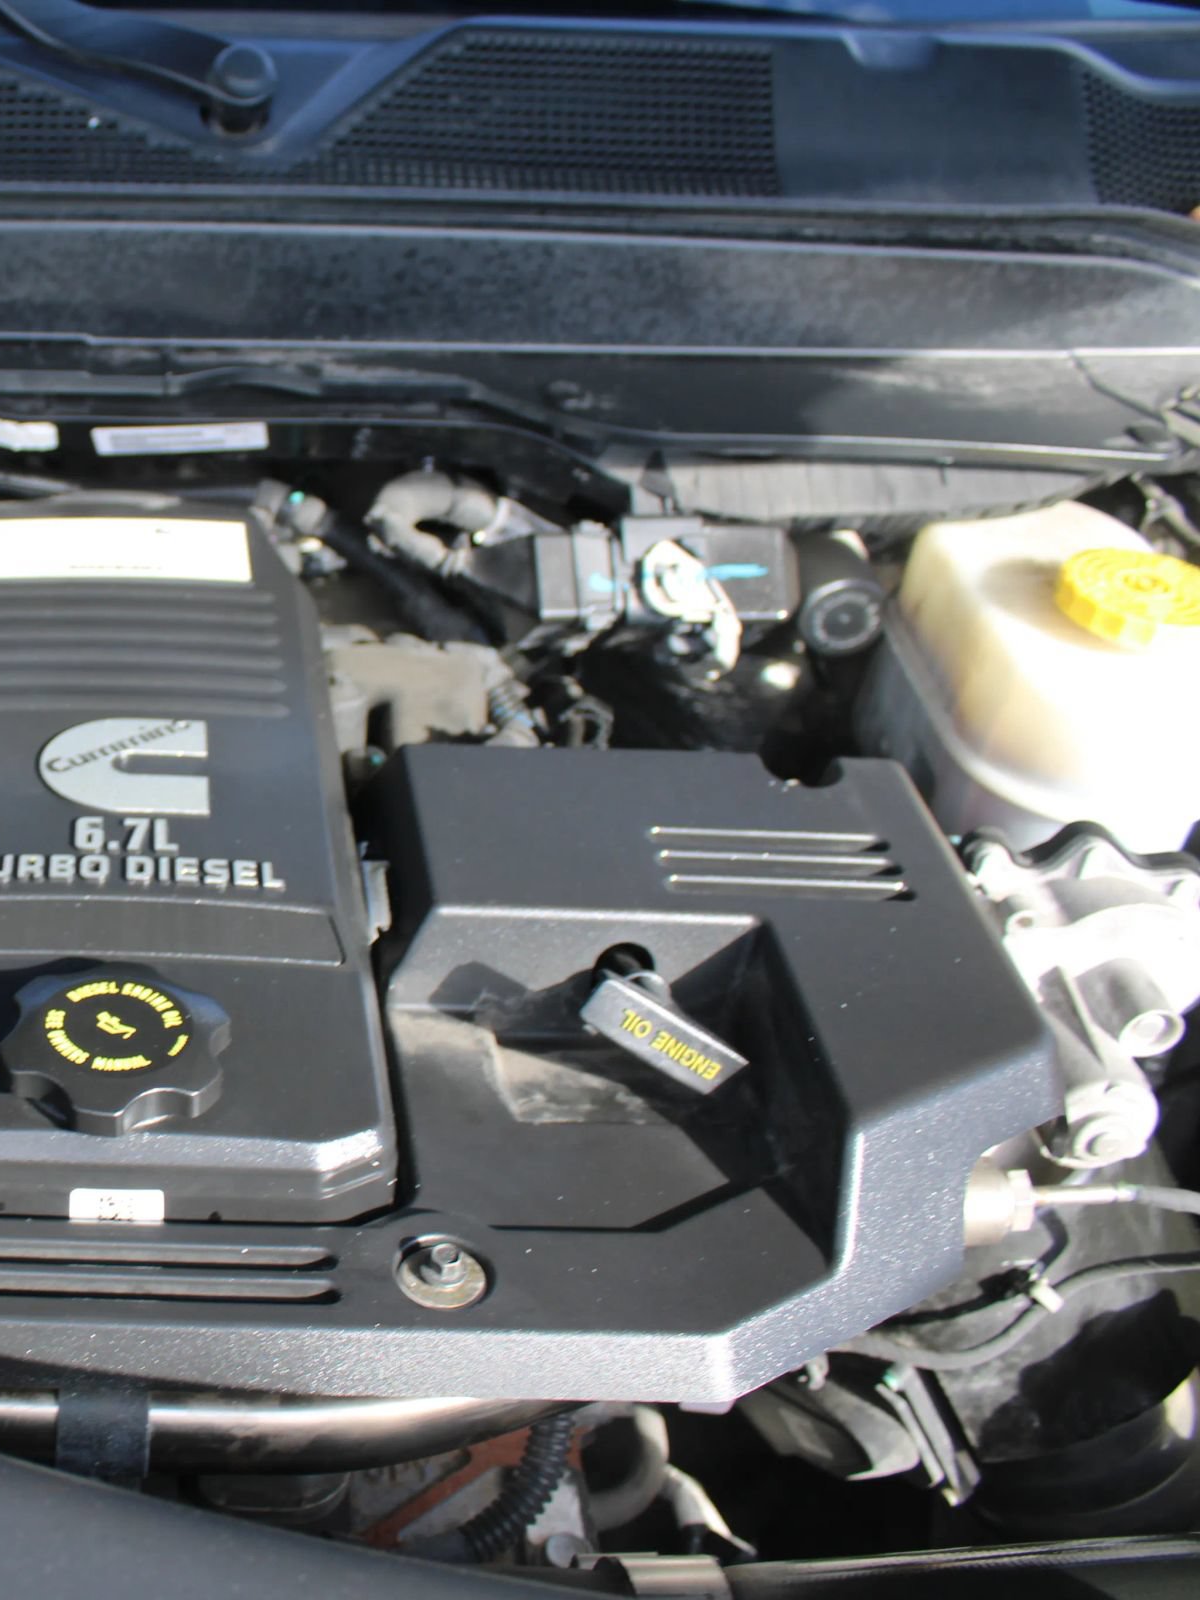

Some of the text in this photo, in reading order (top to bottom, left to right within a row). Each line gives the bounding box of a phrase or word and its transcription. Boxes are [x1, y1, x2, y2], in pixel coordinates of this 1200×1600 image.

[46, 719, 191, 773] Cummins
[73, 815, 179, 853] 6.7L
[124, 855, 286, 890] DIESEL
[120, 982, 174, 1013] ENGINE
[160, 1009, 184, 1029] OIL
[621, 1008, 723, 1081] ENGINE OIL
